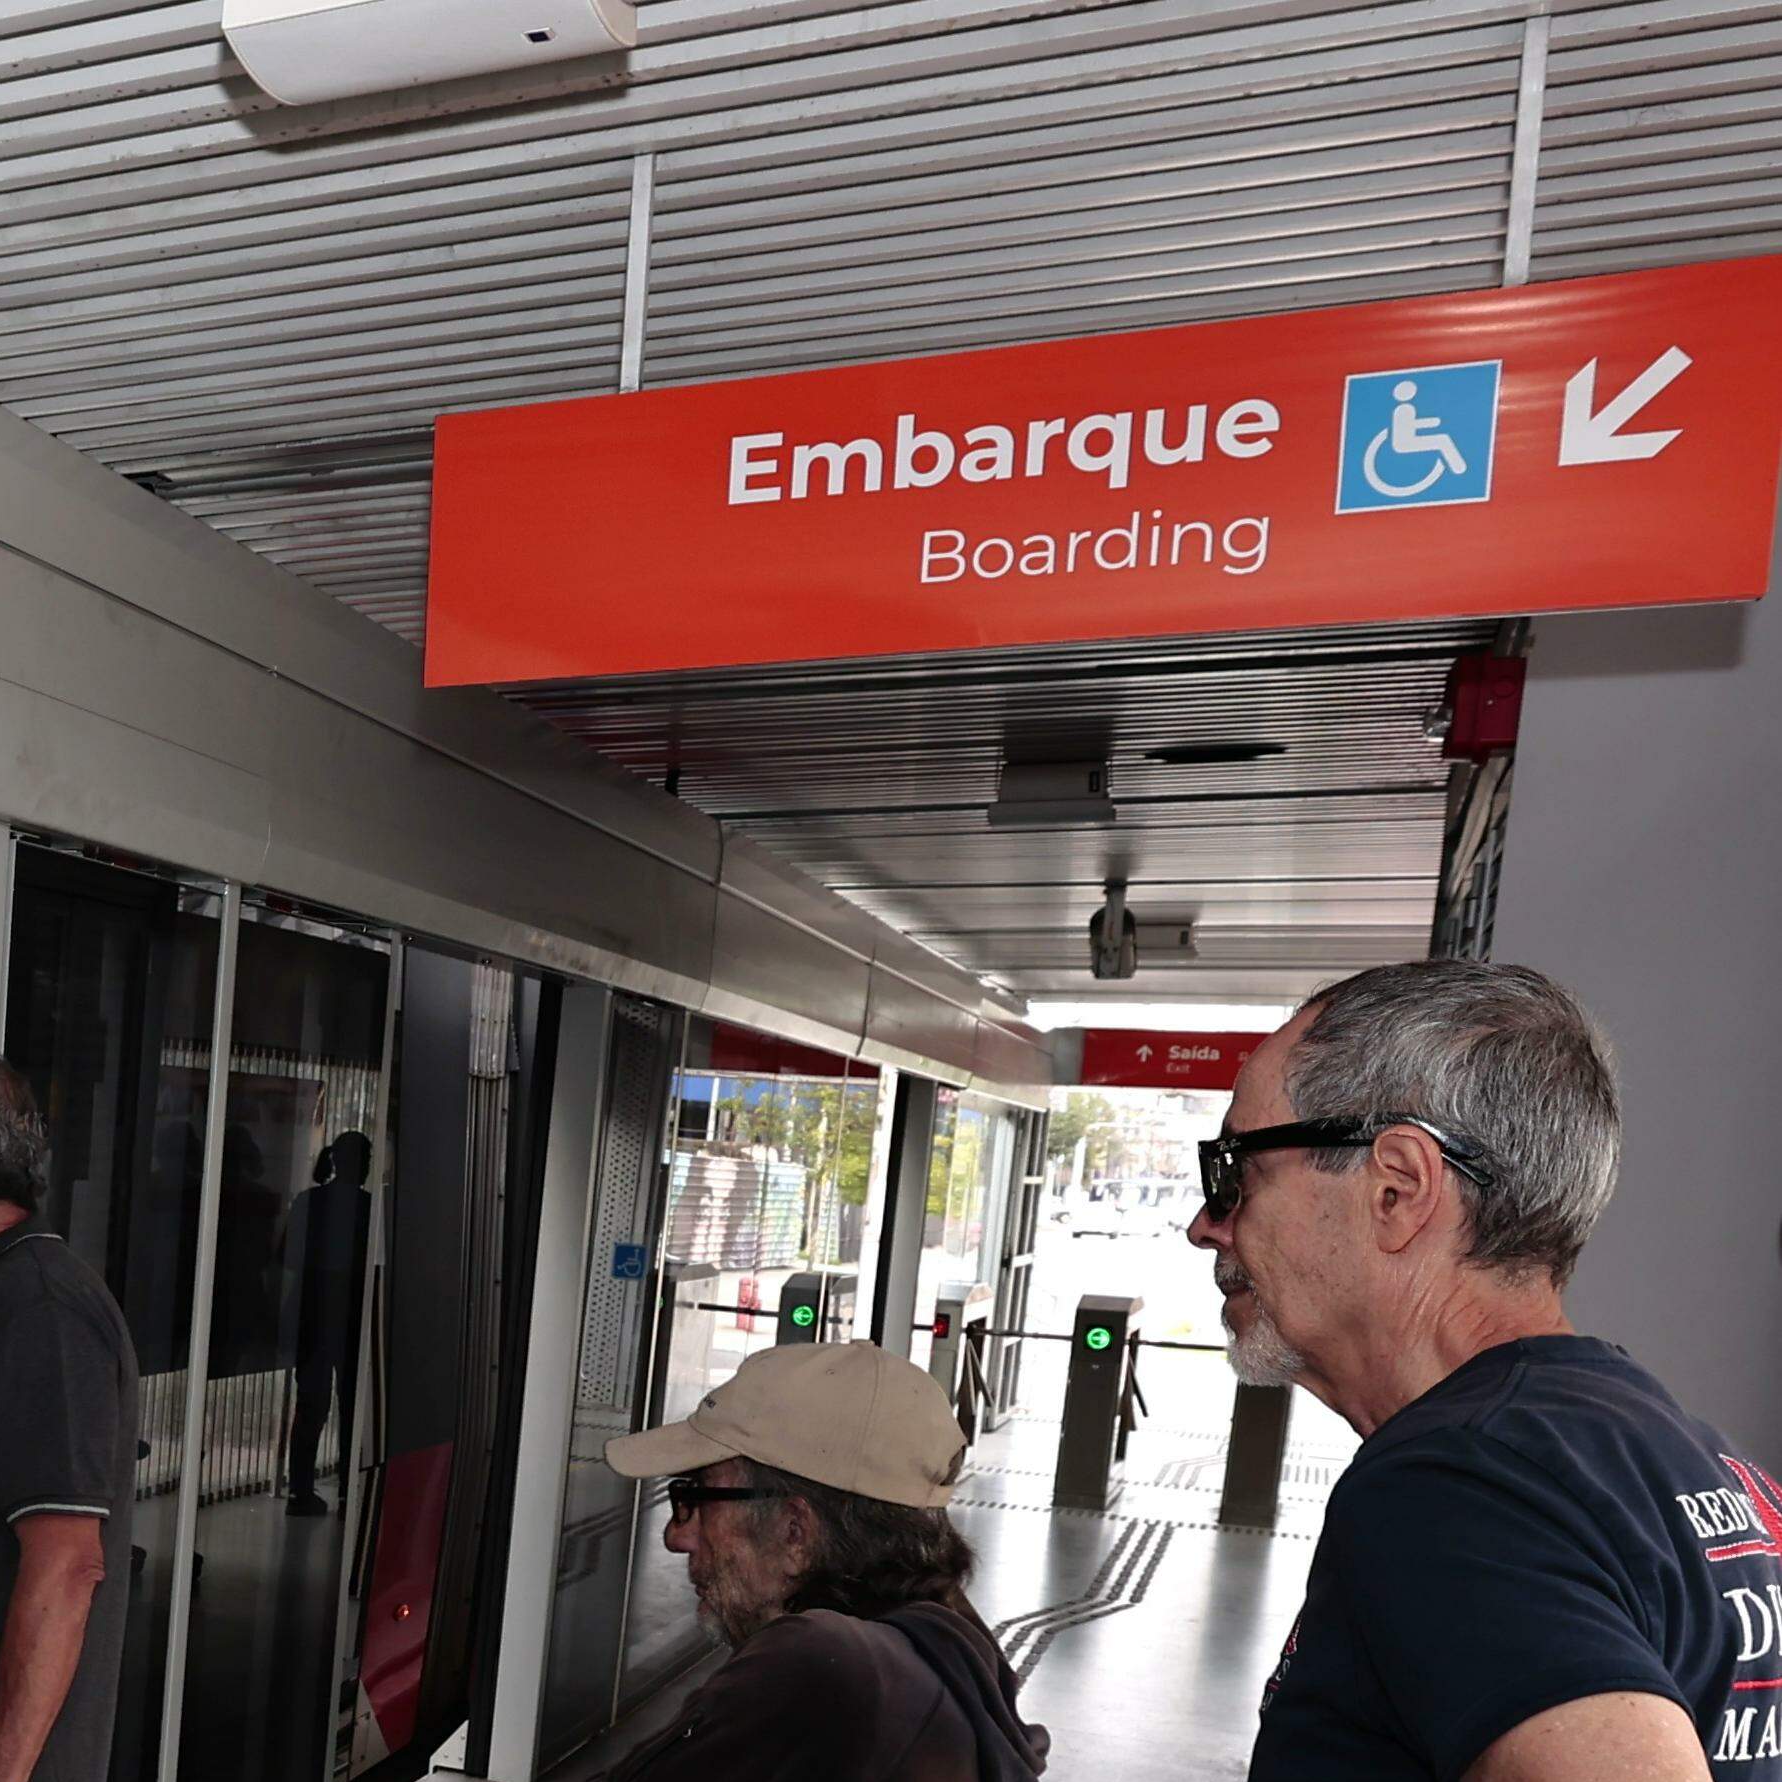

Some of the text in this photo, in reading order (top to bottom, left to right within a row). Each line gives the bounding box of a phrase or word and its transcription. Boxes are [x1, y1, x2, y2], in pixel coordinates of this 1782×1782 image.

[728, 398, 1281, 506] Embarque
[920, 508, 1270, 584] Boarding
[1167, 1063, 1190, 1073] Exit
[1169, 1046, 1220, 1060] Saída
[1713, 1704, 1782, 1761] MA
